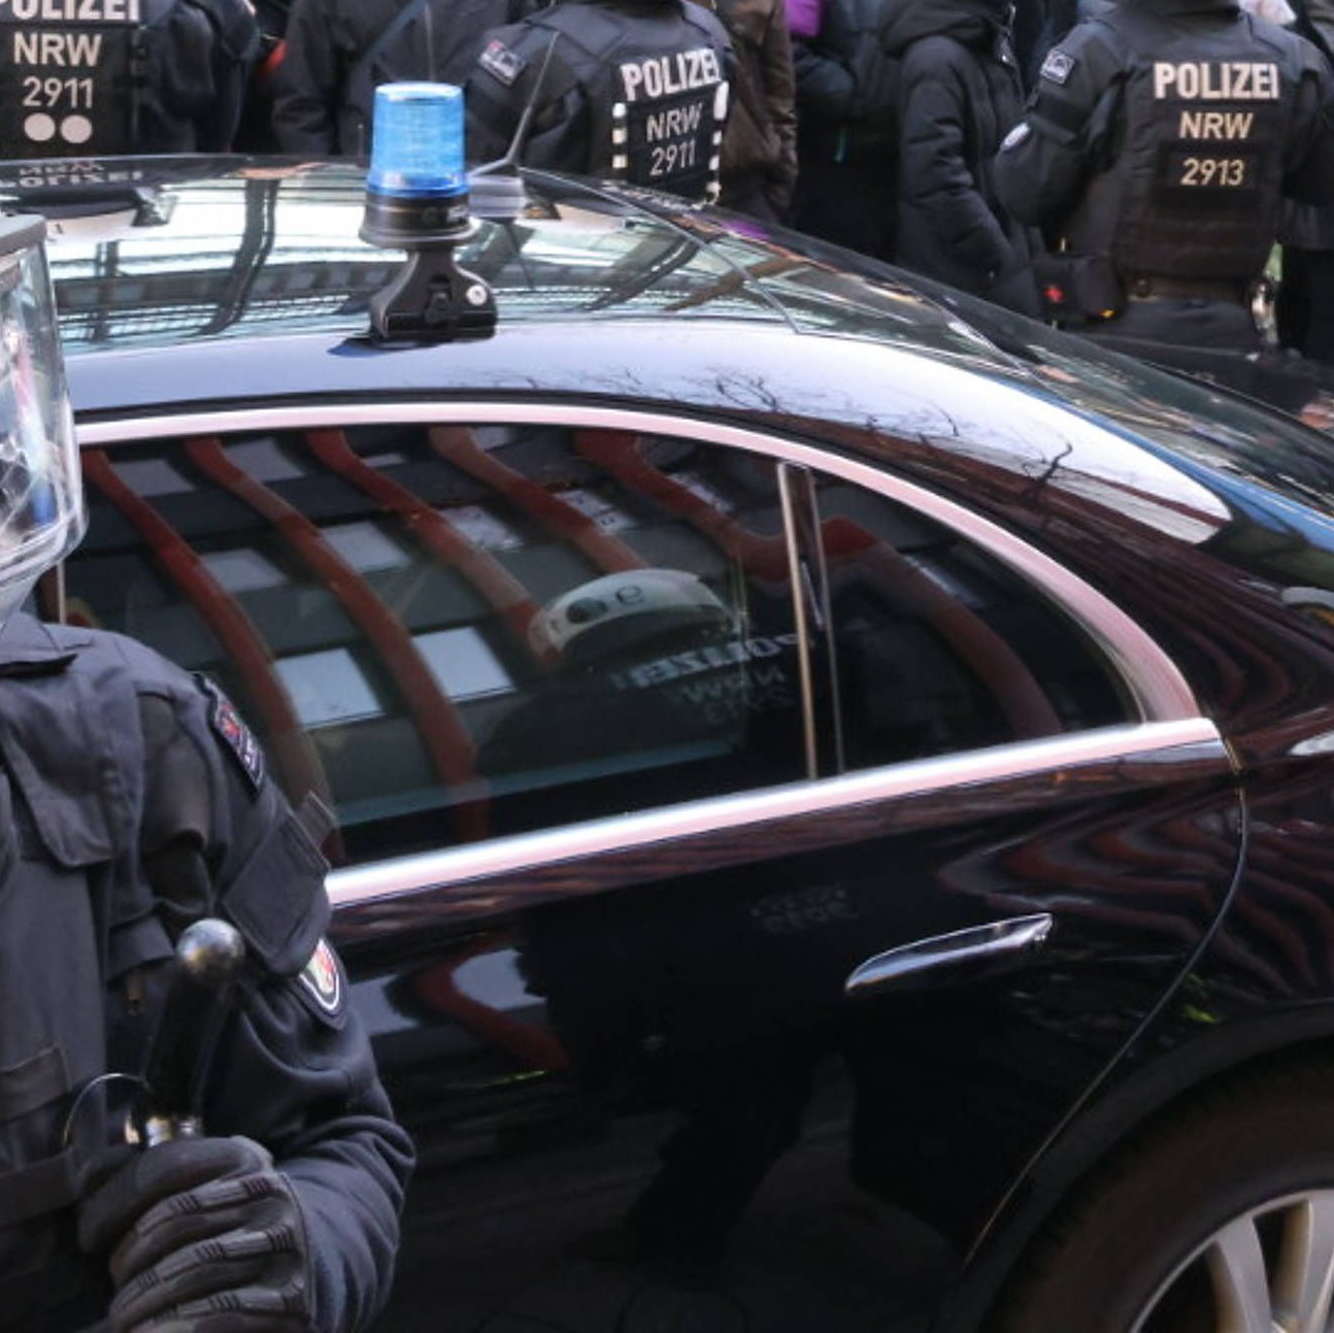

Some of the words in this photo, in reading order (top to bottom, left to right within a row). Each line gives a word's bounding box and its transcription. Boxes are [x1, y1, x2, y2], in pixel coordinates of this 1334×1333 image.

[12, 32, 102, 66] NRW
[22, 76, 94, 109] 2911
[1153, 62, 1280, 99] POLIZEI
[646, 102, 703, 143] NRW
[1179, 111, 1253, 139] NRW
[649, 139, 696, 177] 2911
[1179, 156, 1245, 187] 2913
